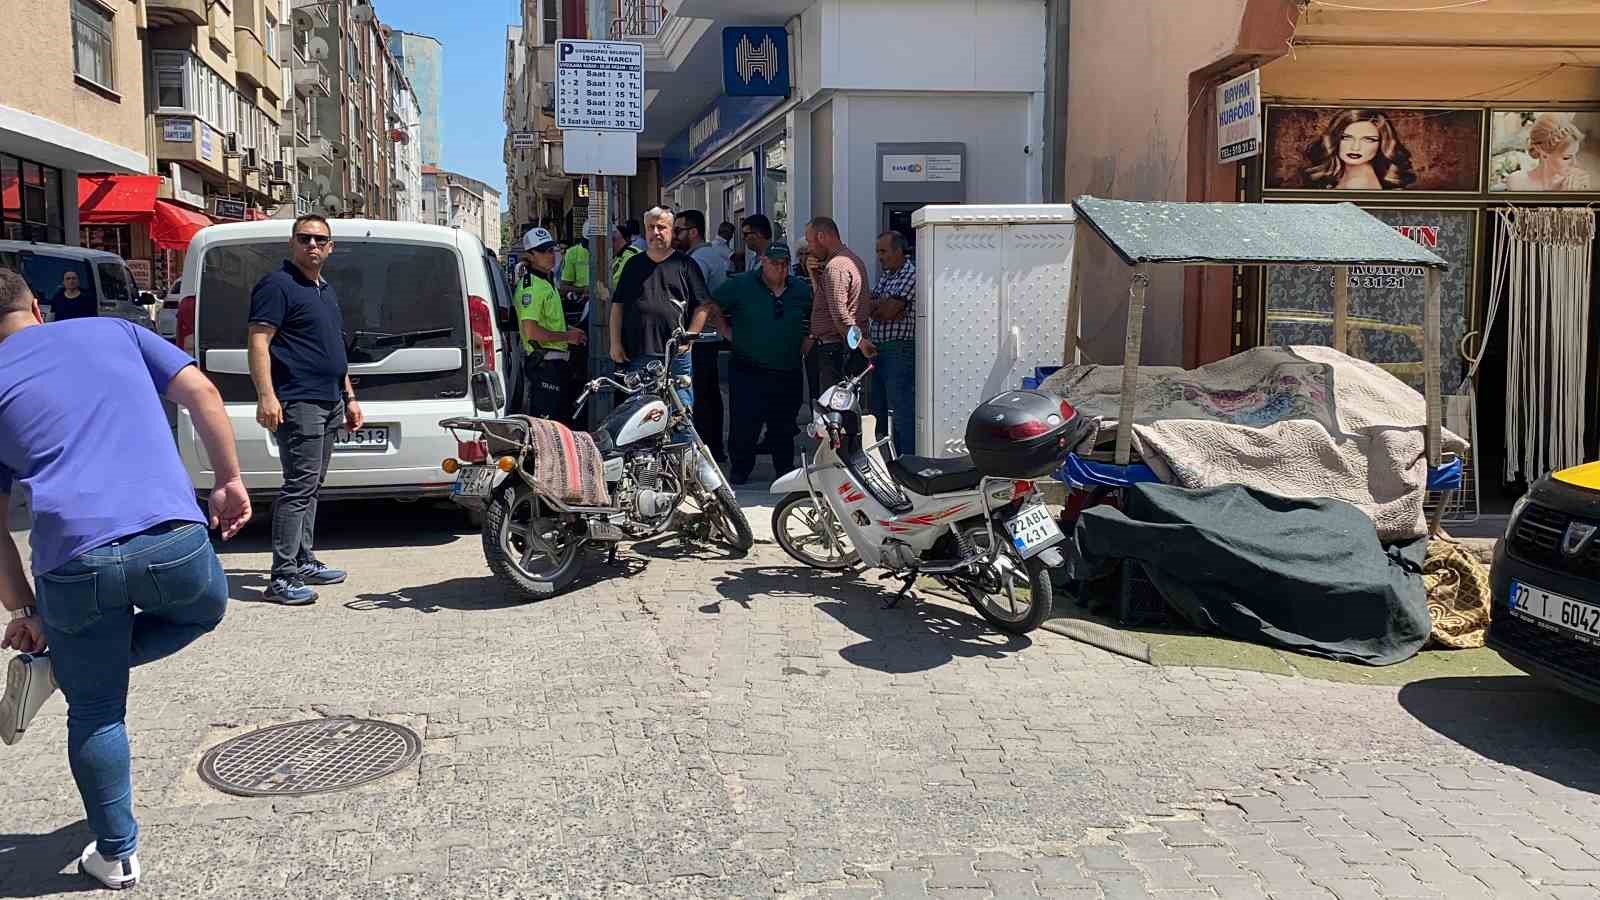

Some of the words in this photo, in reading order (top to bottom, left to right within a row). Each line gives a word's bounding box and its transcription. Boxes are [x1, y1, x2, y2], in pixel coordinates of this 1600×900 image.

[560, 44, 574, 61] P
[587, 89, 606, 97] Saat
[1225, 80, 1249, 104] BAYAN
[1219, 97, 1254, 126] KUAFÖRÜ
[355, 430, 385, 443] 513
[1026, 526, 1048, 543] 431
[1516, 586, 1529, 611] 22
[1542, 594, 1549, 616] T
[1562, 601, 1600, 635] 6042
